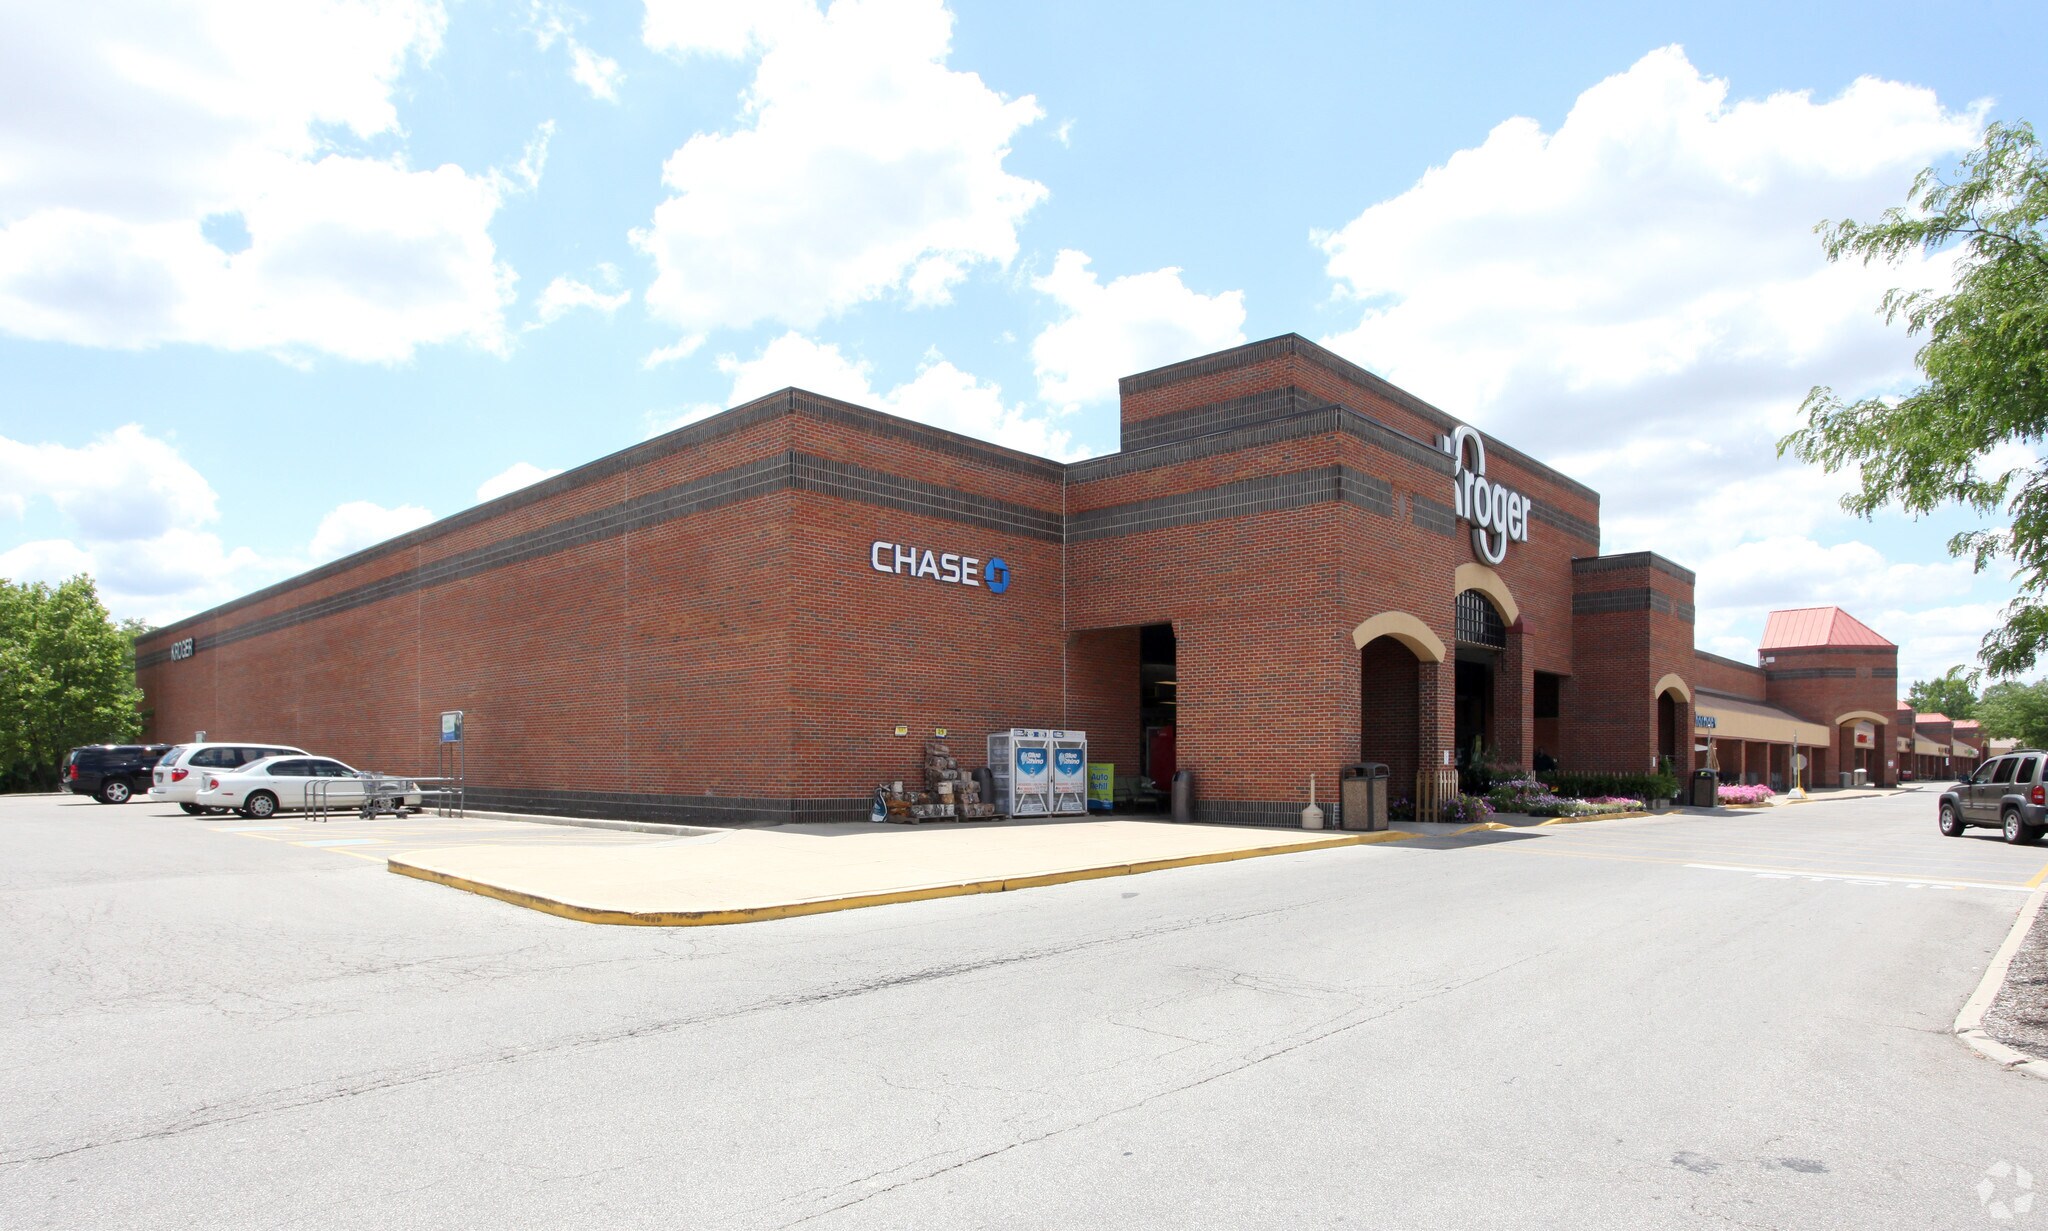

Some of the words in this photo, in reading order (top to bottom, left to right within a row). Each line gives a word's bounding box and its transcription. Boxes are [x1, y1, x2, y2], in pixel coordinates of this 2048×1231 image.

[871, 541, 980, 587] CHASE
[171, 637, 193, 661] KROGER
[1091, 773, 1109, 781] Auto
